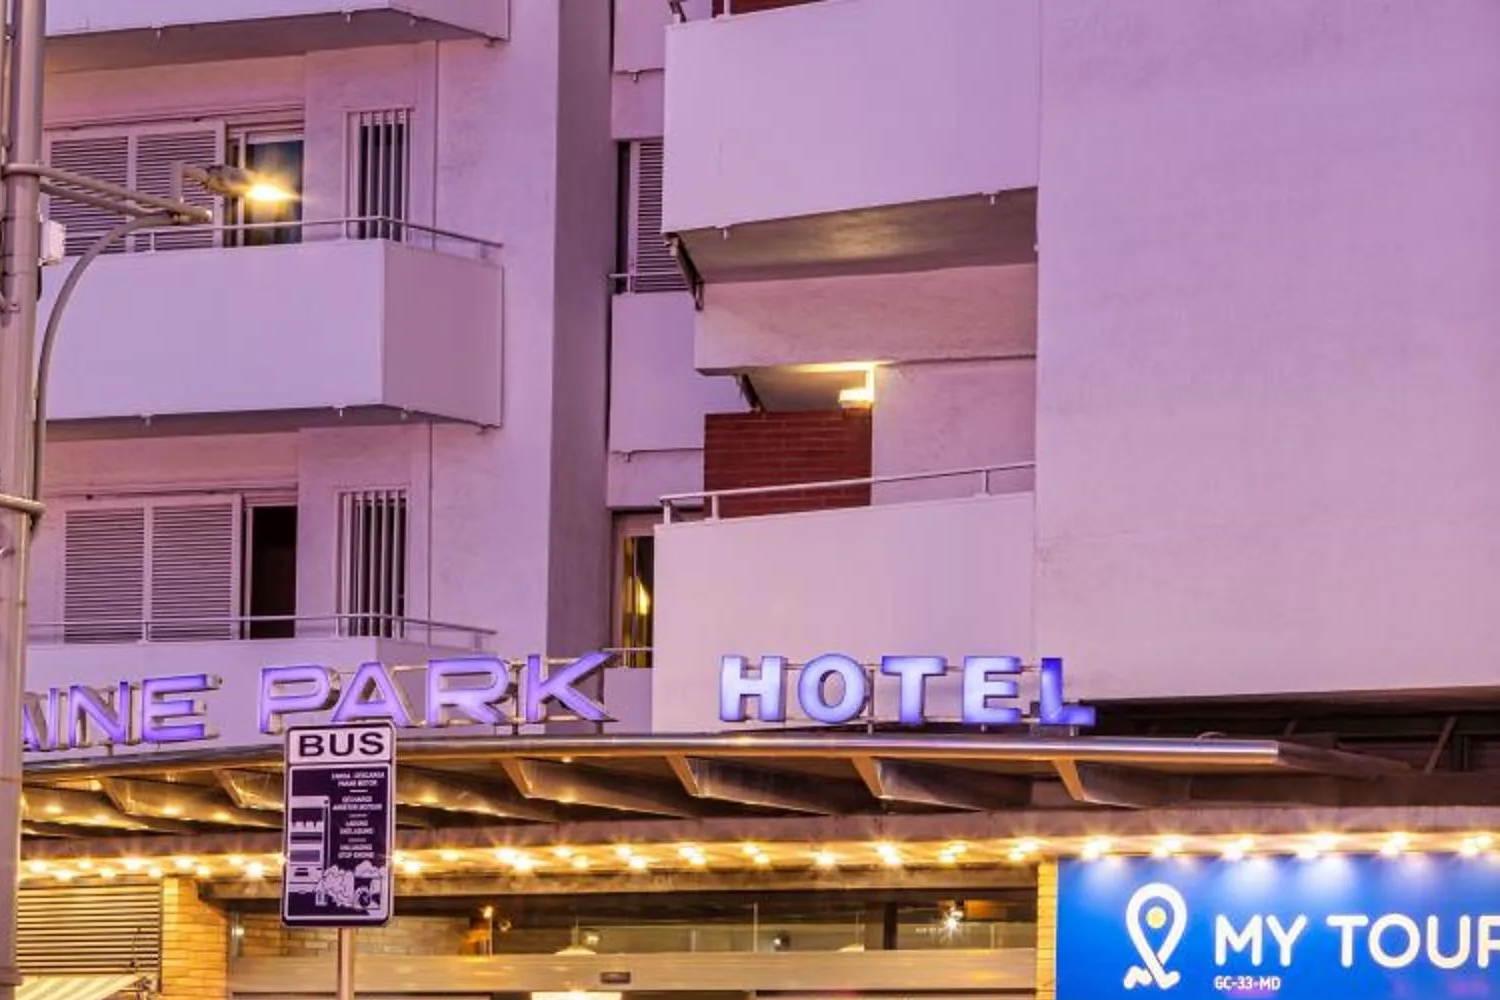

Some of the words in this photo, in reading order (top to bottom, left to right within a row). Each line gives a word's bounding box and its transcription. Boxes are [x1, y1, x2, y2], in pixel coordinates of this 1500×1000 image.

[259, 652, 613, 735] PARK
[720, 654, 1095, 727] HOTEL
[299, 732, 385, 757] BUS
[1214, 914, 1308, 967] MY
[1214, 976, 1281, 991] GC-33-MD
